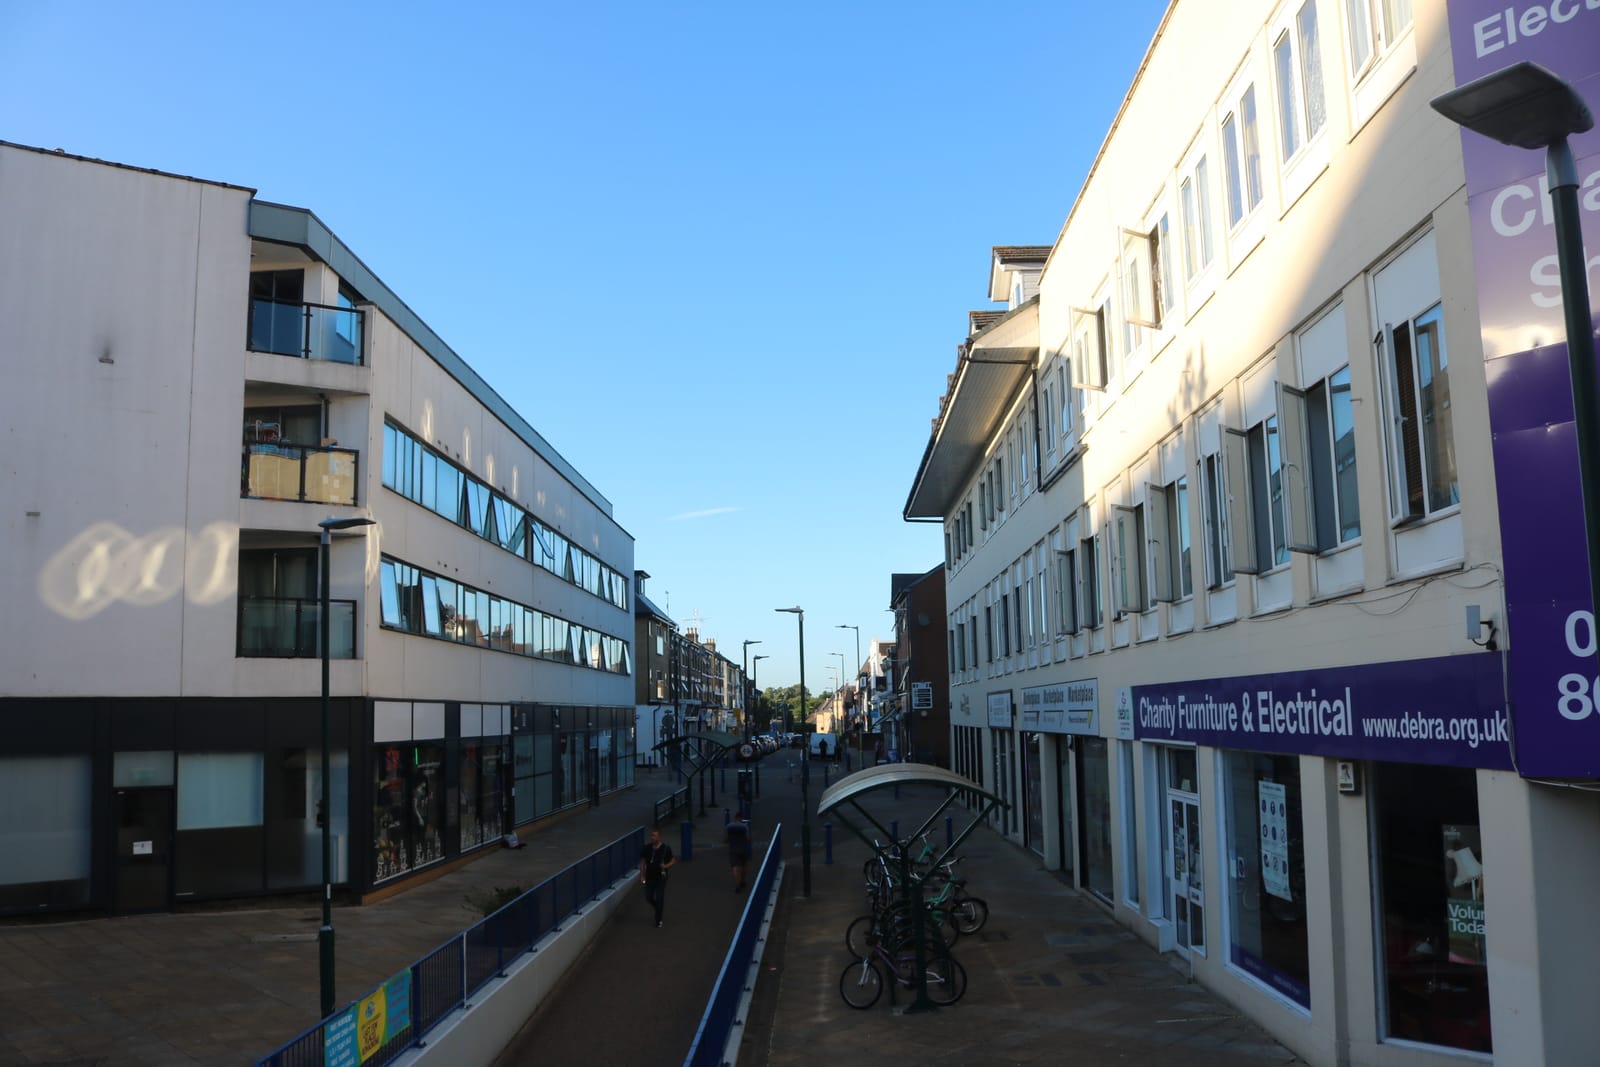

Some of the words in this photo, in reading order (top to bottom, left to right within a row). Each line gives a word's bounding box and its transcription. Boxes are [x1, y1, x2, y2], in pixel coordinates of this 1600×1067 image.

[1473, 0, 1600, 59] Elec
[1140, 695, 1176, 736] Charity
[1178, 693, 1238, 732] Furniture
[1242, 691, 1255, 732] &
[1257, 686, 1353, 736] Electrical
[1557, 673, 1600, 720] 8
[1361, 710, 1510, 748] www.debra.org.uk
